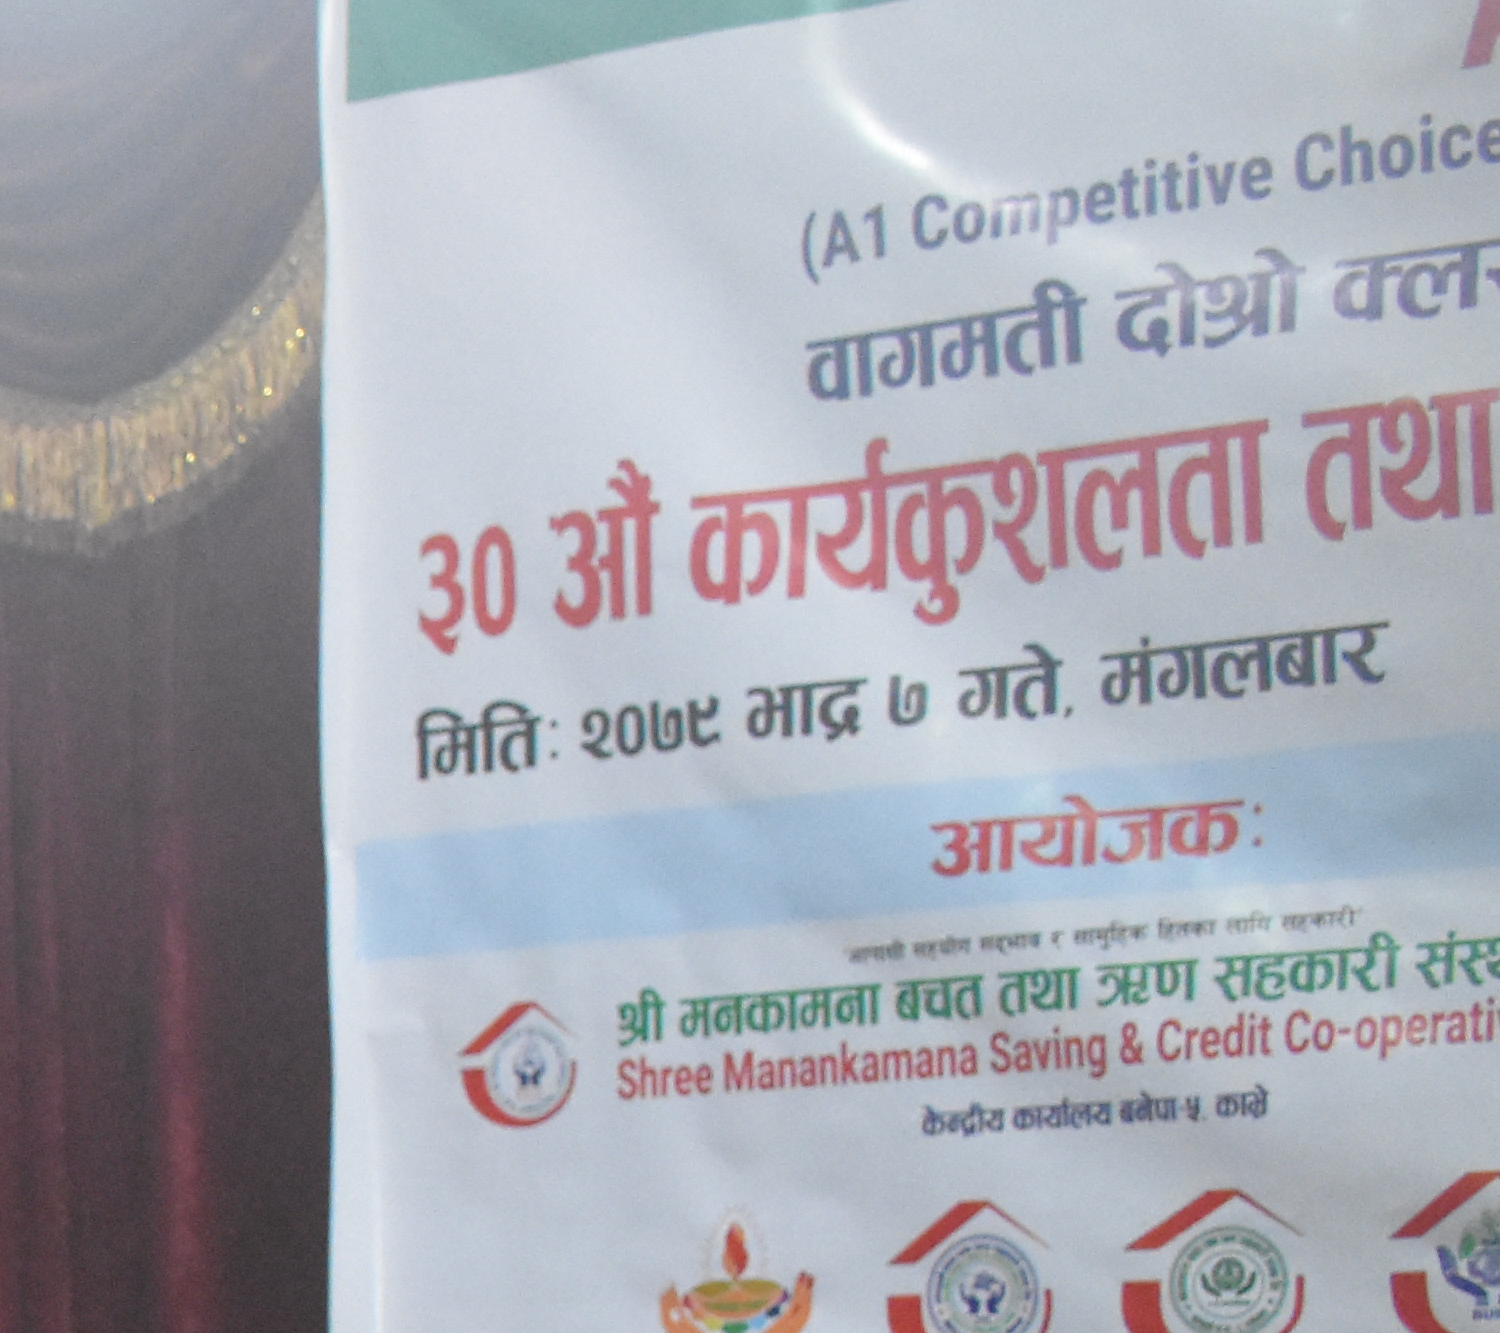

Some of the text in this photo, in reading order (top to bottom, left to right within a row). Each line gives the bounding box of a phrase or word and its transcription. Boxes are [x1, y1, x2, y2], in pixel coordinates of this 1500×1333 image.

[800, 205, 888, 285] (A1
[911, 150, 1273, 250] Competitive
[806, 279, 1088, 400] वागमती
[1333, 237, 1500, 321] क्ल
[418, 520, 517, 656] ३०
[688, 418, 1270, 627] कार्यकुशलता
[1300, 386, 1500, 543] तथा
[580, 694, 722, 760] २०७९
[745, 677, 868, 742] भाद्र
[887, 673, 928, 727] ७
[1100, 618, 1391, 706] मंगलबार
[617, 985, 667, 1049] श्री
[678, 981, 883, 1039] मनकामना
[894, 973, 985, 1023] बचत
[998, 963, 1083, 1020] तथा
[1213, 929, 1402, 1003] सहकारी
[617, 1055, 713, 1103] Shree
[723, 1040, 980, 1094] Manankamana
[988, 1024, 1109, 1080] Saving
[1118, 1019, 1144, 1066] &
[1155, 1010, 1273, 1062] Credit
[1283, 995, 1500, 1062] Co-operati
